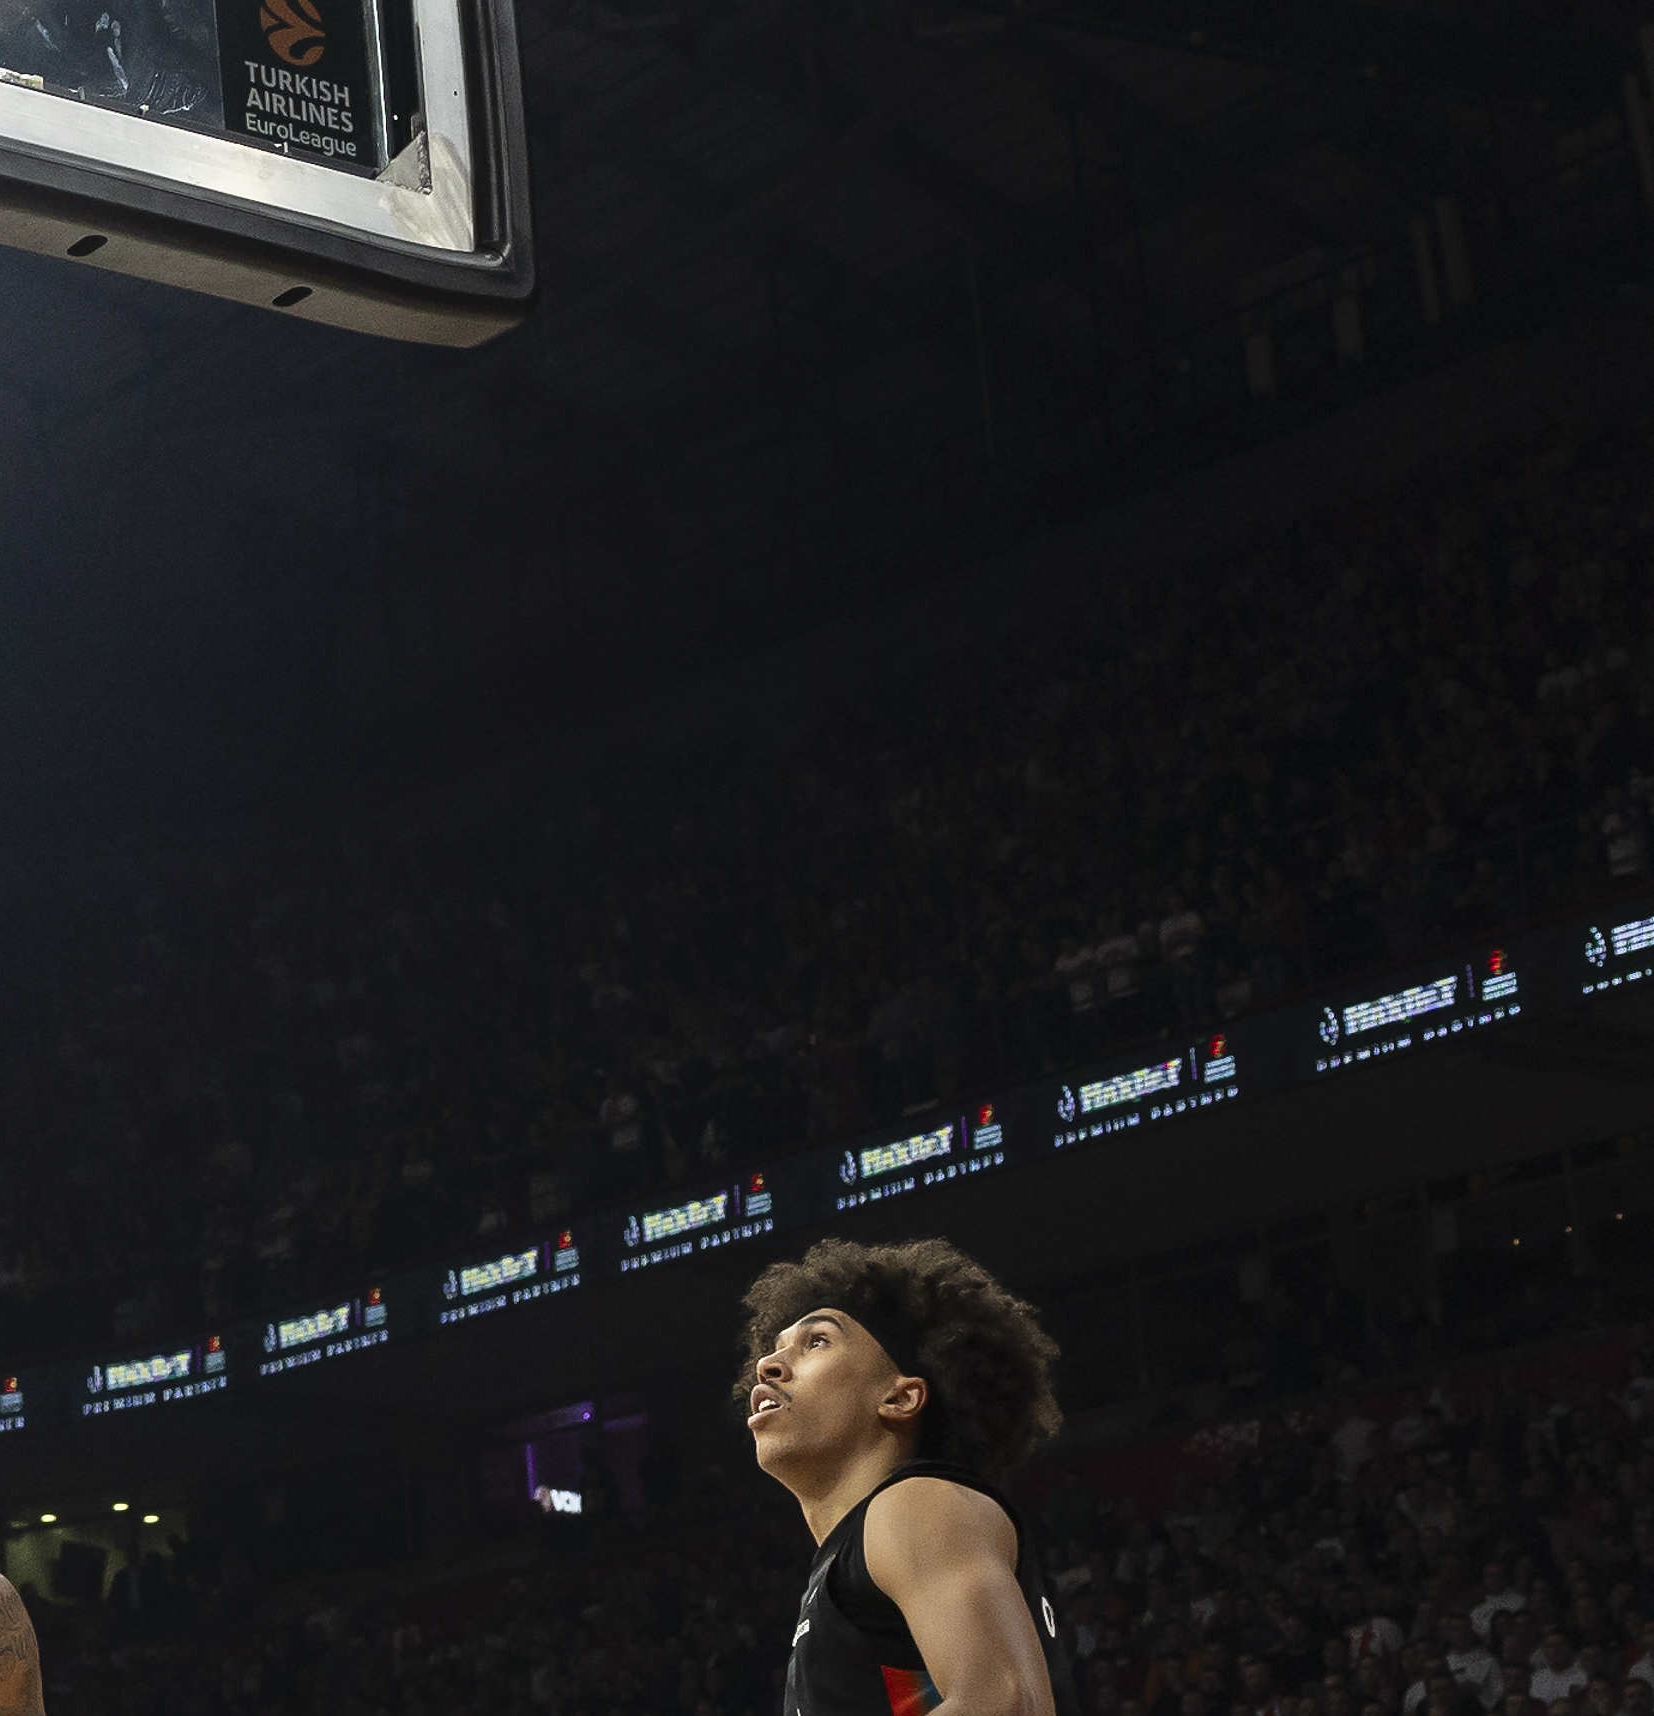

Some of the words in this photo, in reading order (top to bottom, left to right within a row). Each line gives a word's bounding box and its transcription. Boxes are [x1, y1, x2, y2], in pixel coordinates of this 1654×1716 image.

[245, 61, 350, 107] TURKISH
[245, 87, 354, 133] AIRLINES
[245, 113, 357, 156] EuroLeague
